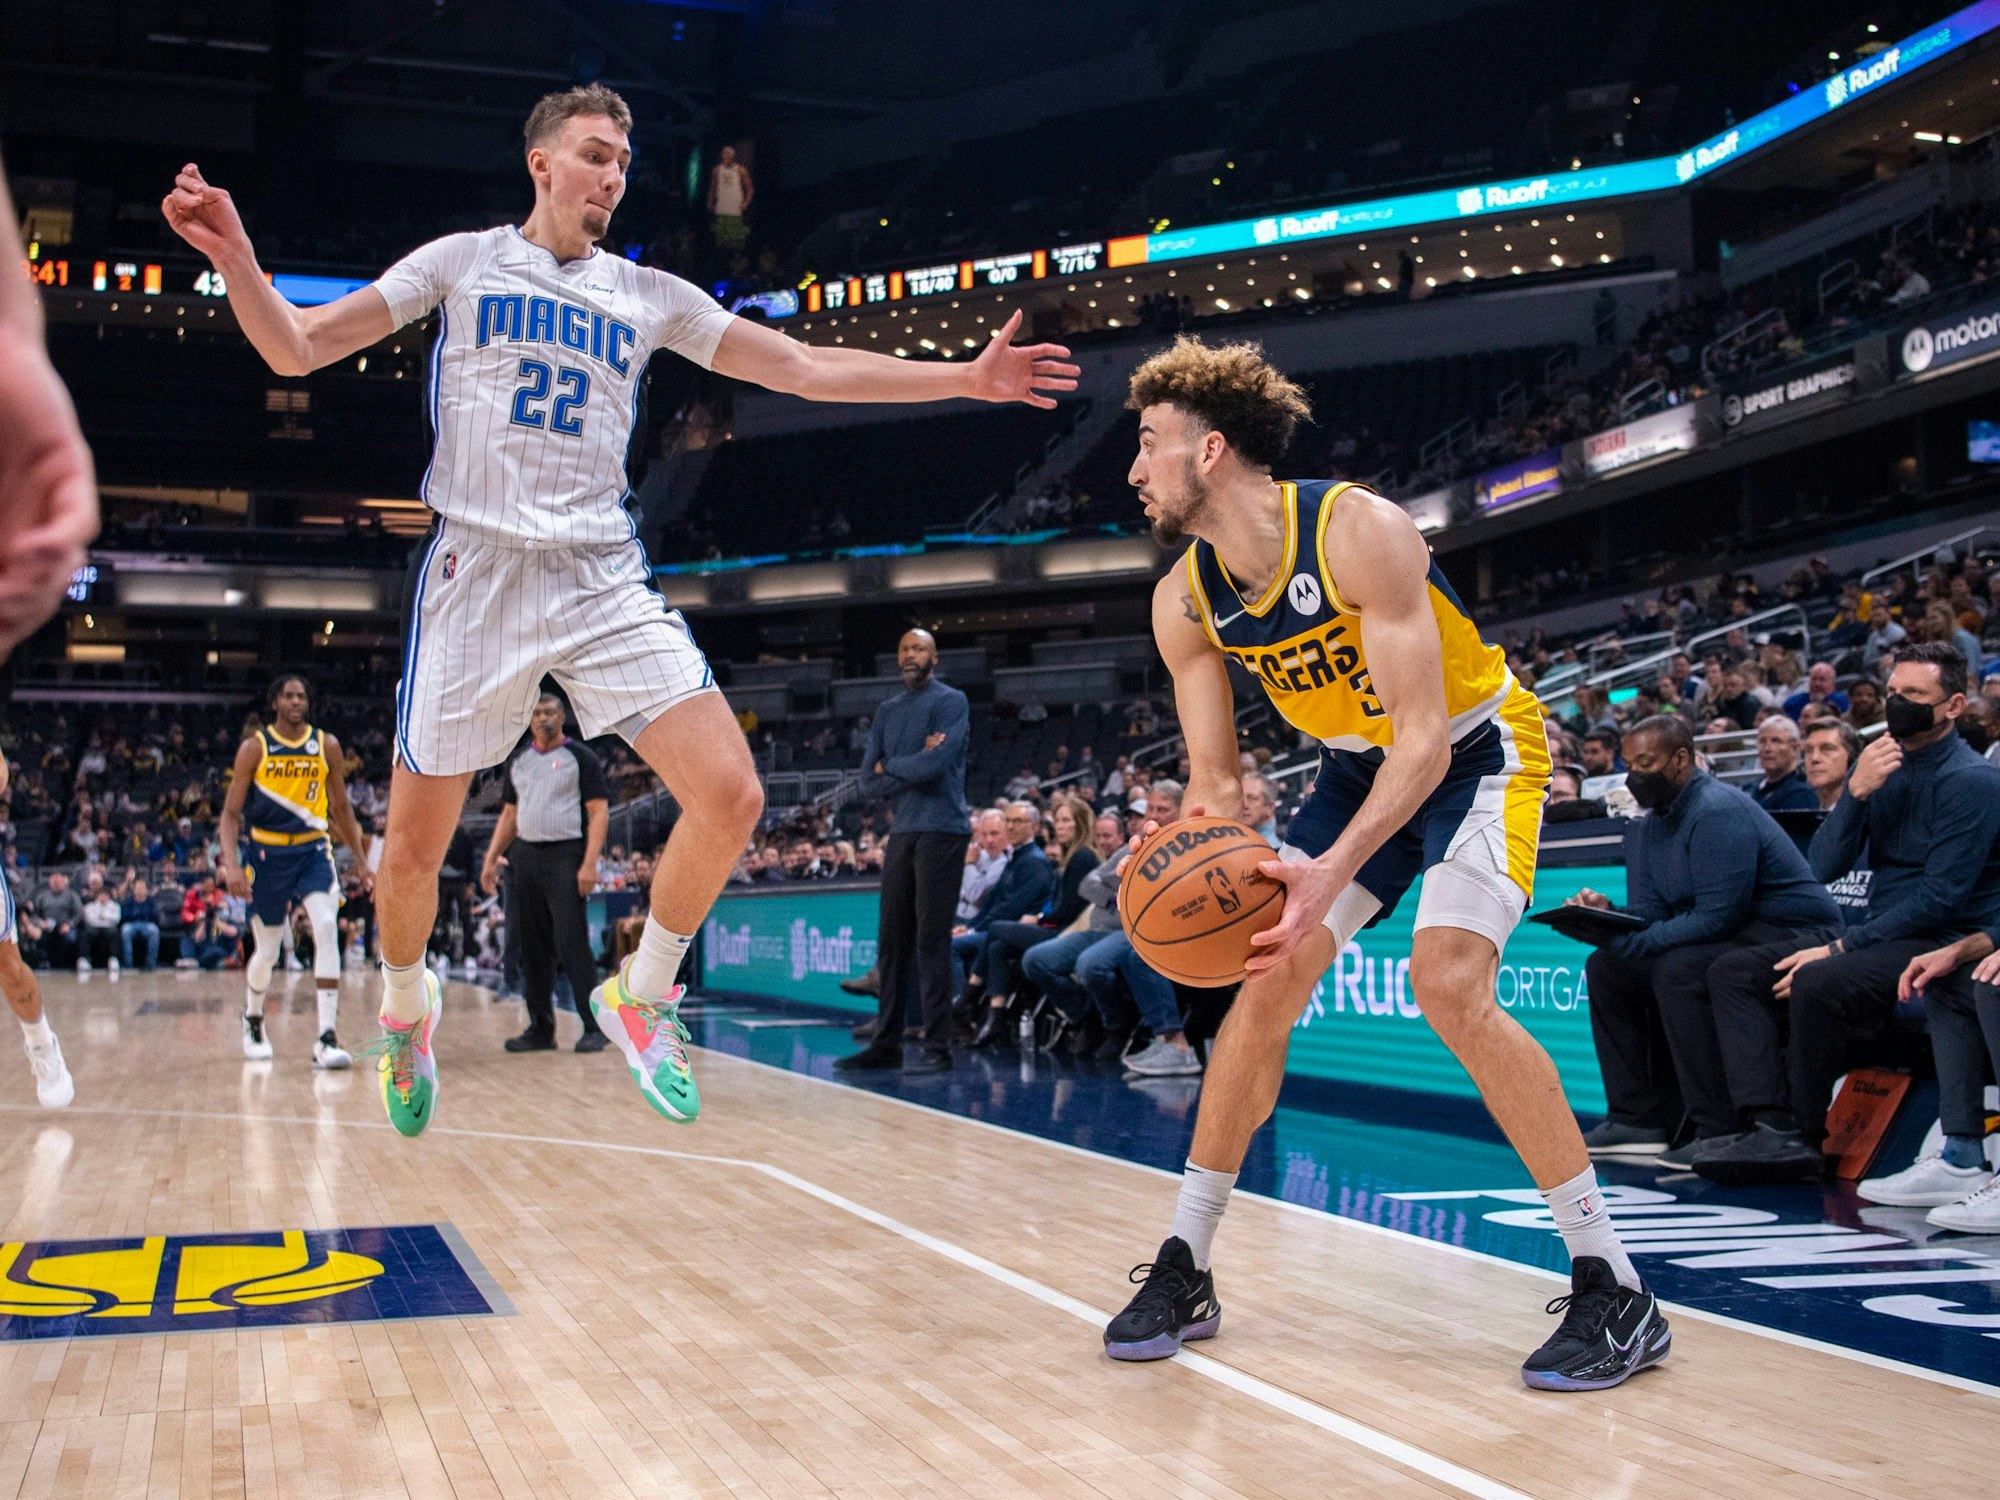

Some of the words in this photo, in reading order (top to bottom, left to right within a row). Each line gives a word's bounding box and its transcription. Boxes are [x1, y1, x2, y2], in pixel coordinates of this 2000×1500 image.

[1849, 48, 1900, 93] Ruoff
[1486, 179, 1549, 207] Ruoff
[1280, 210, 1339, 237] Ruoff
[22, 259, 69, 287] :41
[987, 266, 1018, 284] 0/0
[1058, 254, 1097, 274] 7/16
[118, 275, 132, 291] 2
[193, 270, 227, 296] 43
[866, 285, 886, 303] 15
[910, 275, 955, 296] 18/40
[825, 291, 845, 309] 17
[476, 293, 636, 379] MAGIC
[510, 358, 590, 437] 22
[1743, 385, 1785, 415] SPORT
[1786, 363, 1855, 400] GRAPHICS
[265, 759, 319, 779] PACERS
[305, 780, 321, 803] 8
[1138, 825, 1248, 882] Wilson
[809, 926, 852, 975] Ruoff
[1334, 941, 1424, 1019] Ruo
[1494, 965, 1589, 1011] ORTGA
